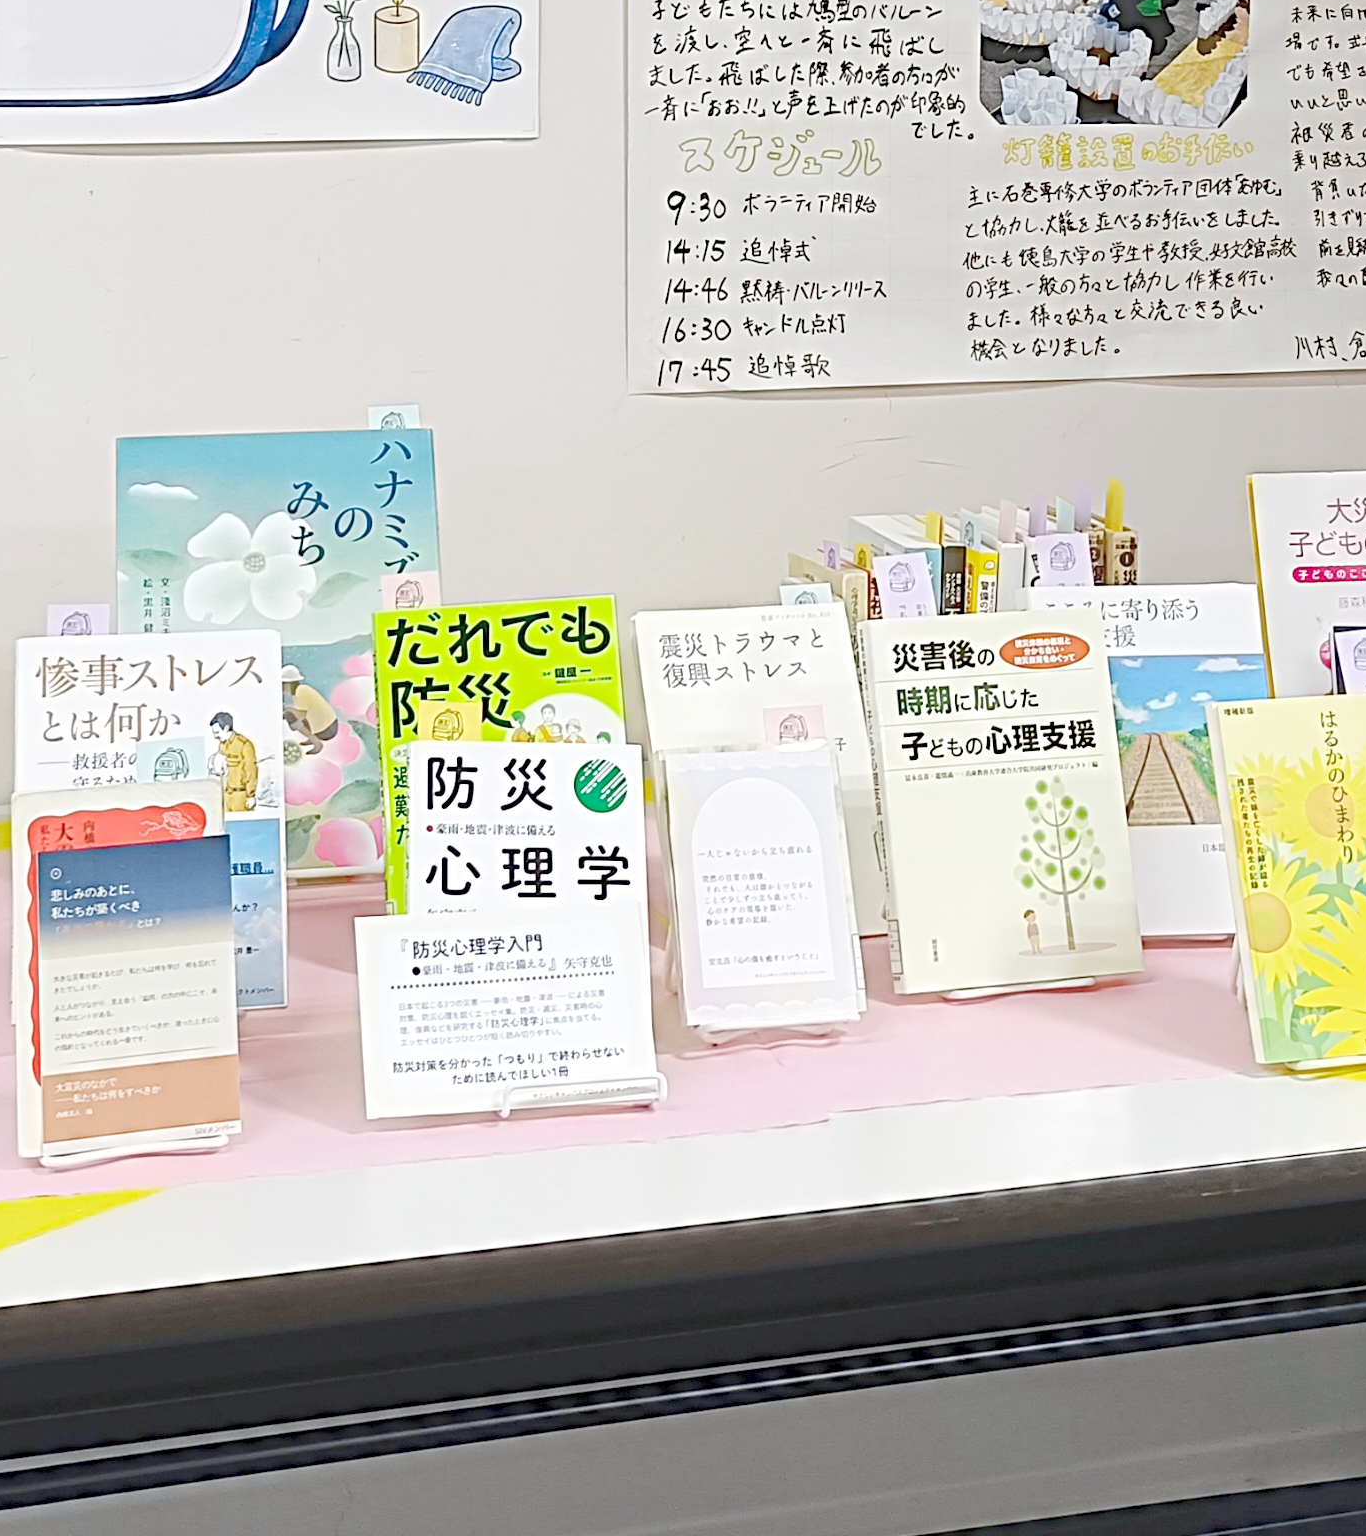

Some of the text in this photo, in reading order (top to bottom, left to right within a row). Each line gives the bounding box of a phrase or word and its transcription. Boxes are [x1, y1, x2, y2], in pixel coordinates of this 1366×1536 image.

[912, 121, 975, 140] でした。
[679, 129, 882, 177] スケジュール
[667, 191, 727, 225] 9:30
[666, 238, 726, 264] 14:15
[665, 277, 729, 304] 14:46
[662, 314, 846, 344] 16:30 キャンドル点灯
[658, 354, 831, 387] 17:45 追悼歌
[287, 481, 330, 567] みち
[335, 507, 373, 542] の
[386, 606, 611, 668] だれでも
[659, 627, 825, 660] 震災トラウマと
[892, 639, 995, 674] 災害後の
[36, 655, 263, 698] 惨事ストレス
[663, 660, 808, 689] 復興ストレス
[896, 682, 1040, 717] 時期に応じた
[42, 702, 182, 744] とは何か
[901, 719, 1096, 762] 子どもの心理支援
[427, 757, 553, 811] 防災
[1320, 710, 1355, 864] はるかのひまわり
[696, 844, 813, 859] 一人じゃないから立ち直れる
[426, 844, 631, 900] 心理学
[50, 884, 136, 902] 悲しみのあとに、
[51, 900, 141, 920] 私たちが築くべき
[400, 934, 543, 959] 『防災心理学入門
[564, 955, 613, 970] 矢守克也
[393, 1046, 624, 1074] 防災対策を分かった「つもり」で終わらせない
[452, 1066, 569, 1085] ために読んでほしい1冊
